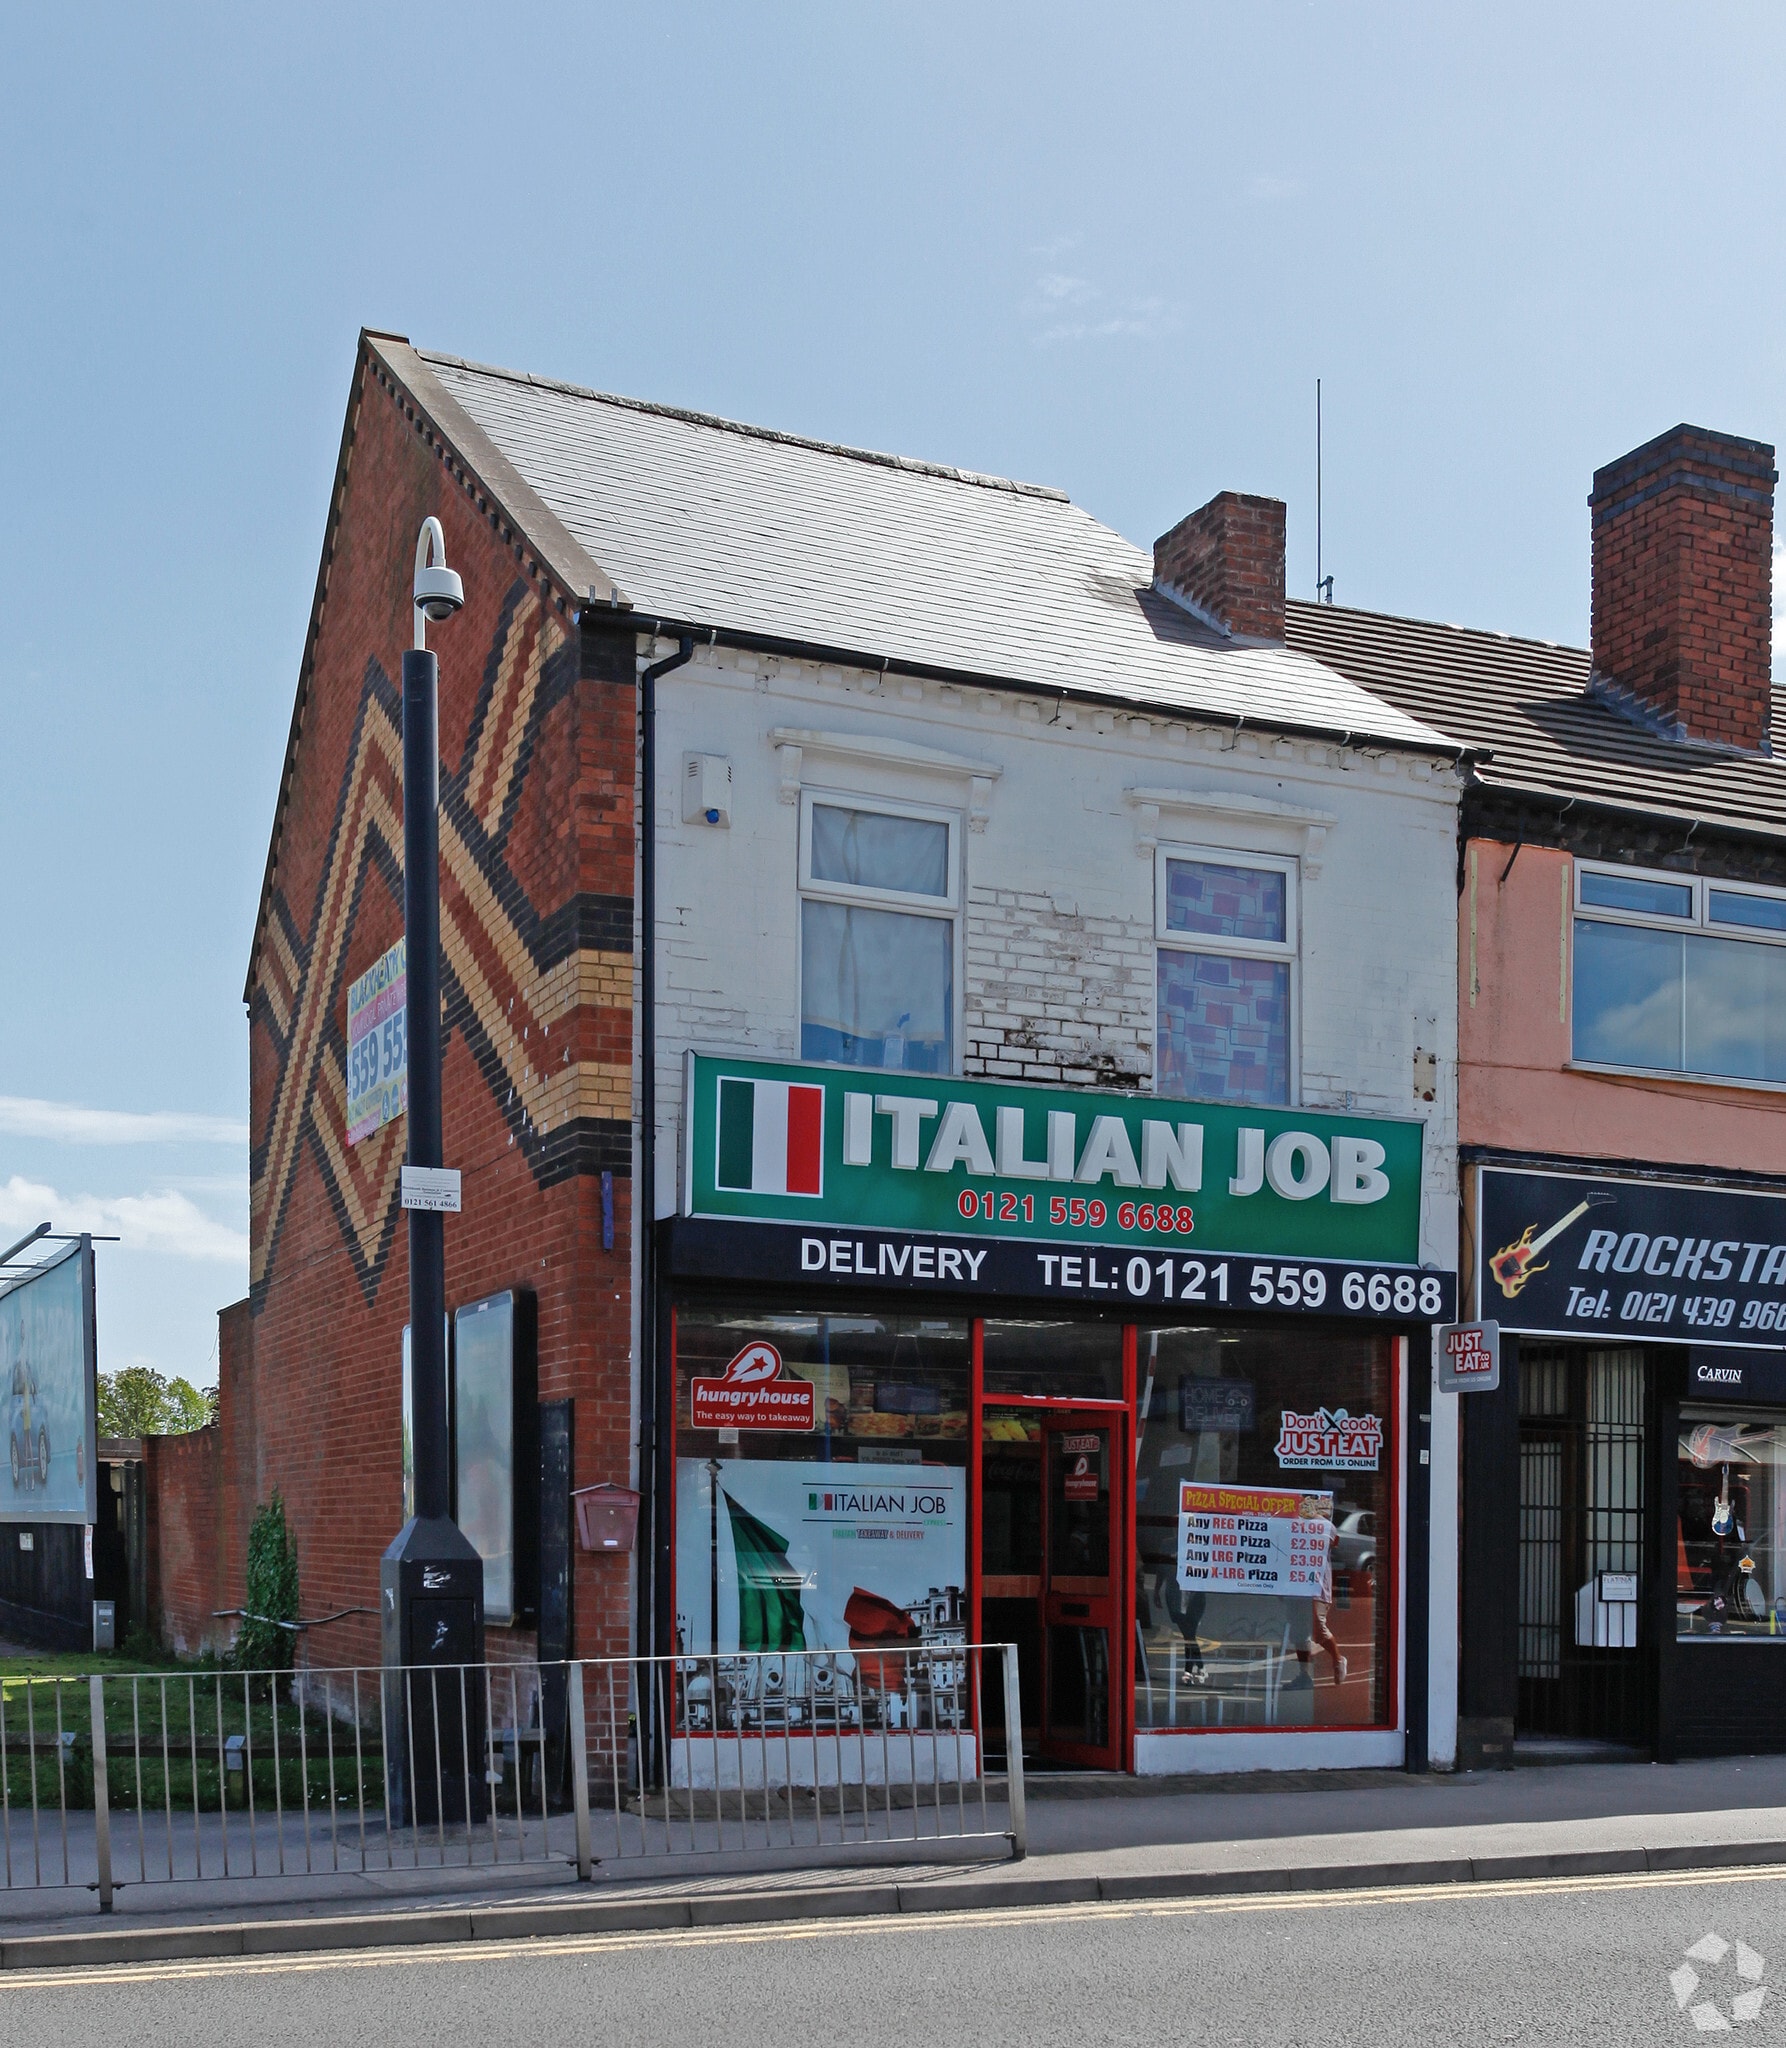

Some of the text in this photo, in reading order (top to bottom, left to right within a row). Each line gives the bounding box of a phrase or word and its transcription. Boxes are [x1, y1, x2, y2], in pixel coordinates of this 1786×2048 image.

[352, 1031, 379, 1100] 559
[843, 1092, 1390, 1204] ITALIAN JOB
[404, 1198, 421, 1206] 0121
[958, 1189, 1194, 1234] 0121 559 6688
[801, 1238, 987, 1281] DELIVERY
[1249, 1265, 1327, 1307] 559
[1342, 1271, 1442, 1315] 6688
[1565, 1286, 1611, 1319] Tel:
[1620, 1291, 1677, 1323] 0121
[1682, 1296, 1736, 1327] 439
[1447, 1332, 1481, 1353] JUST
[1697, 1366, 1742, 1380] CARVIN
[696, 1385, 810, 1407] hungryhouse
[696, 1410, 810, 1424] The easy way to takeaway
[1285, 1413, 1378, 1431] Don't cook
[1280, 1432, 1379, 1455] JUST EAT
[1282, 1457, 1309, 1466] ORDER
[1311, 1458, 1333, 1466] FROM
[1347, 1459, 1376, 1467] ONLINE
[834, 1493, 946, 1514] ITALIAN JOB
[1186, 1490, 1296, 1513] PIZZA SPECIAL OFFER
[896, 1530, 925, 1540] DELIVERY
[1187, 1516, 1324, 1535] Any REG Pizza £1.99
[1187, 1532, 1325, 1551] Any MED Pizza £2.99
[1186, 1549, 1323, 1567] Any LRG Pizza £3.99
[1185, 1565, 1209, 1579] Any
[1211, 1566, 1245, 1579] X-LRG
[1248, 1568, 1278, 1582] Pizza
